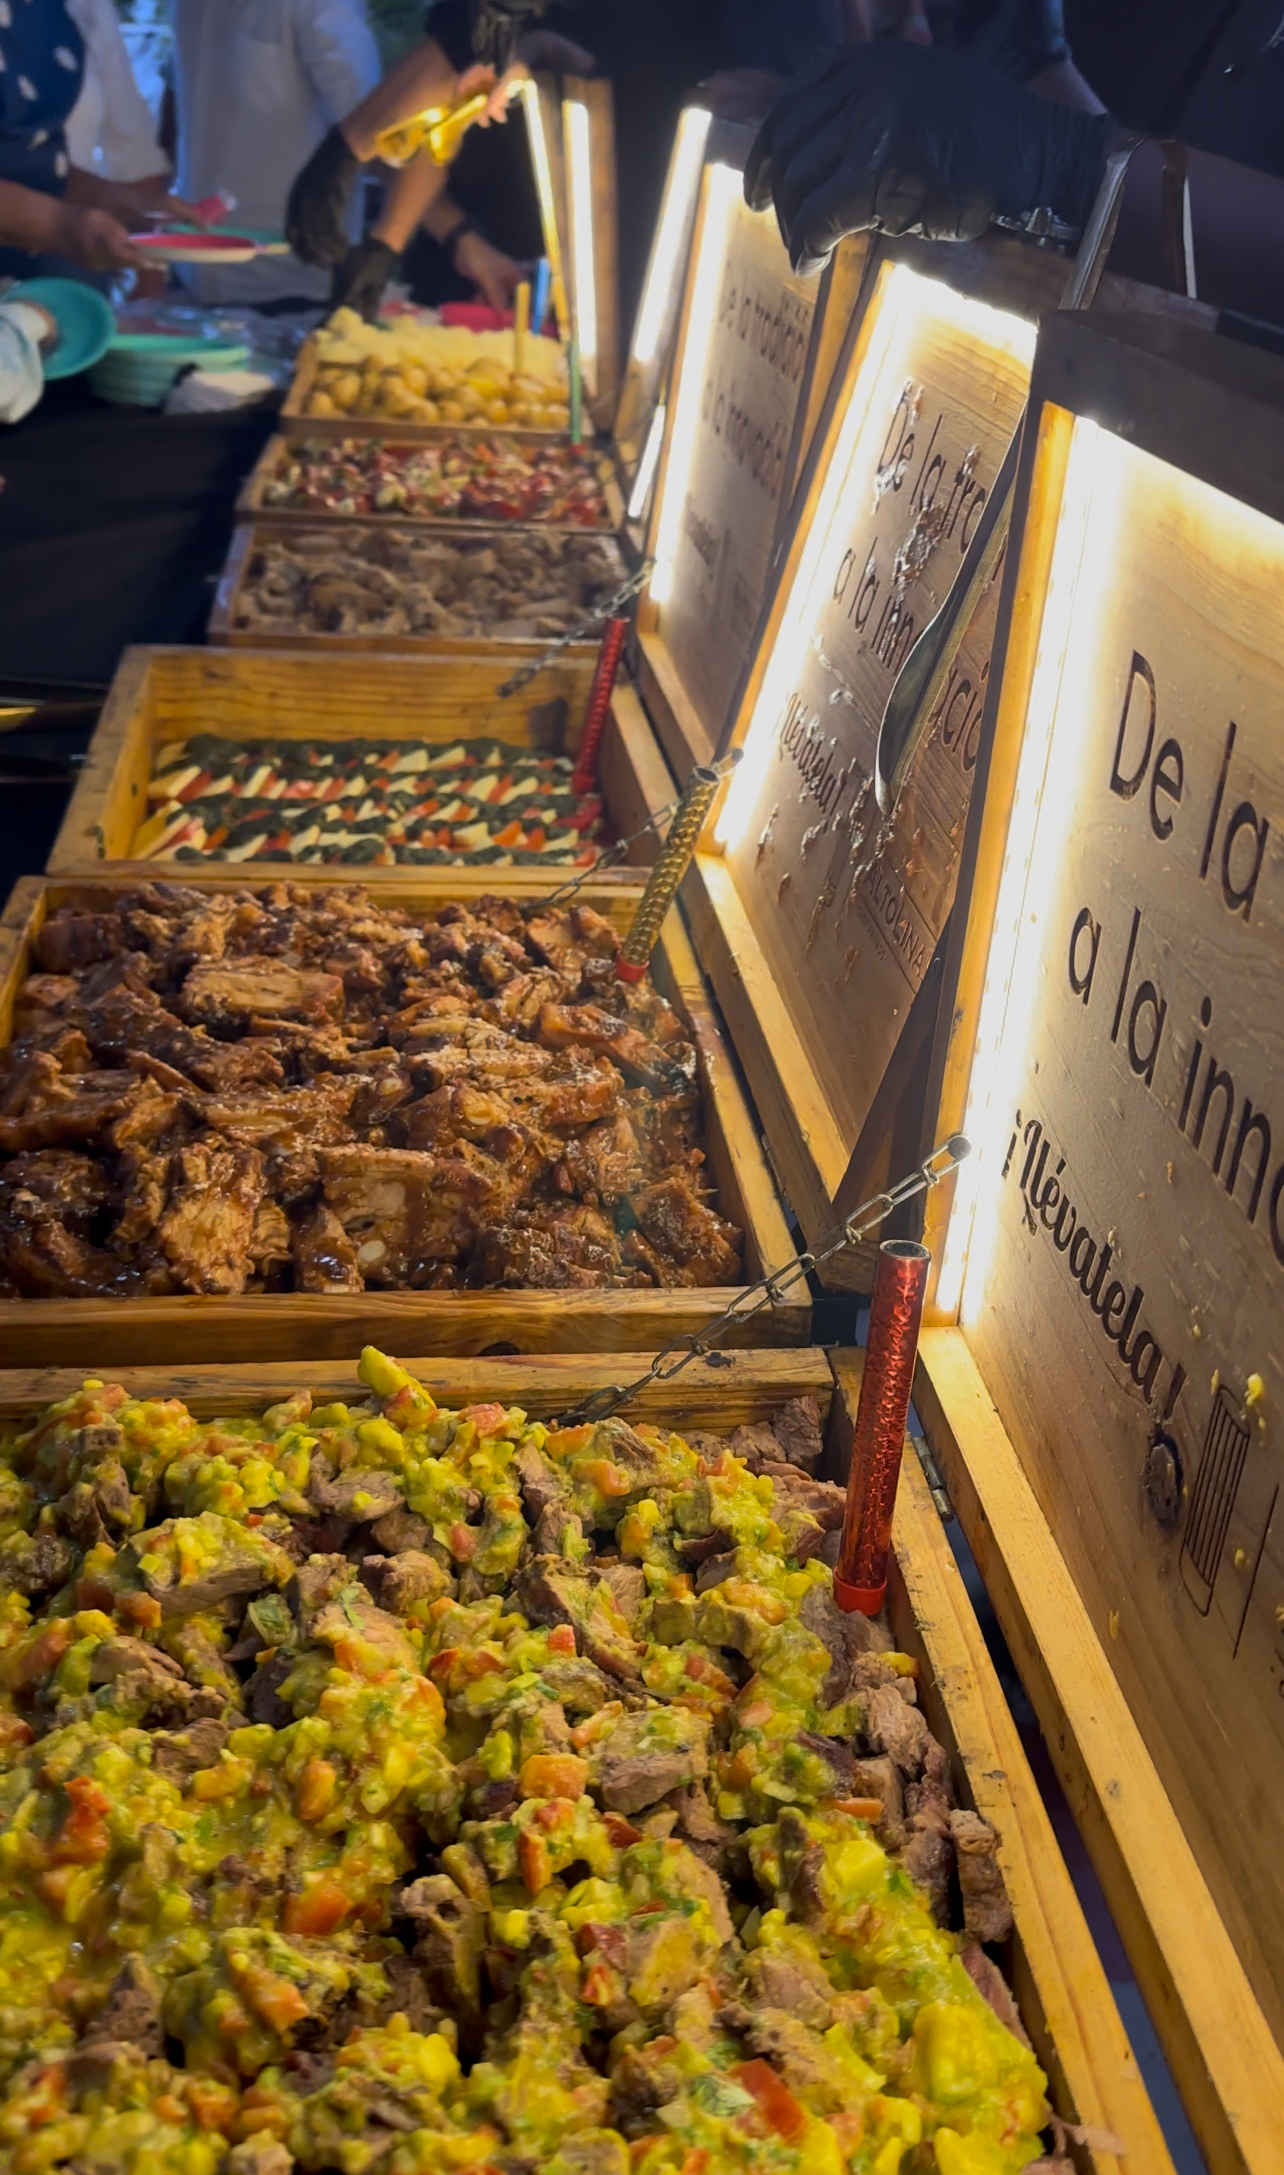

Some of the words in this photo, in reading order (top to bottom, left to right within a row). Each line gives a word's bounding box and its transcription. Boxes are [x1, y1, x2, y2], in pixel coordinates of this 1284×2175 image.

[848, 536, 880, 634] la
[1108, 648, 1185, 842] De
[1199, 719, 1270, 924] la
[1068, 906, 1102, 1008] a
[1110, 906, 1168, 1089] la
